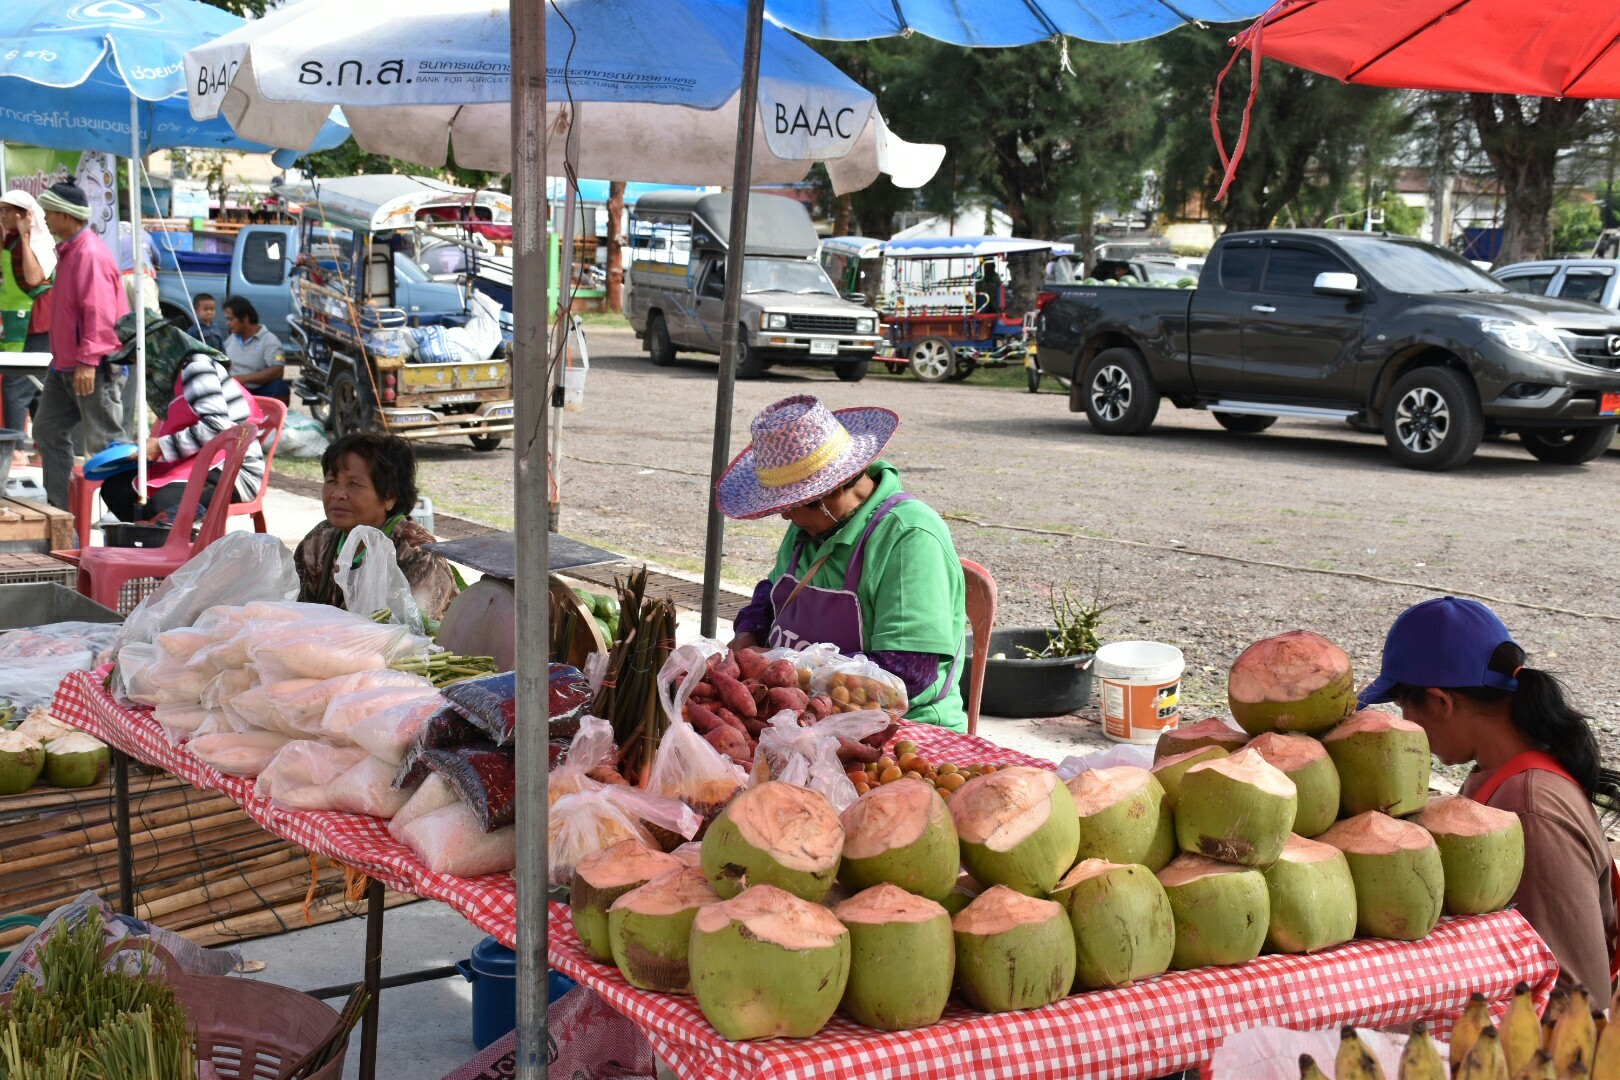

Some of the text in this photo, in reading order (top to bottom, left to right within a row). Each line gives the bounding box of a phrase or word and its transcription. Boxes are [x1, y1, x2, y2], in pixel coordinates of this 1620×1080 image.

[198, 60, 238, 96] BAAC
[298, 59, 412, 86] ธ.ก.ส.
[444, 76, 462, 84] FOR
[466, 76, 511, 84] AGRICULT
[775, 102, 854, 139] BAAC
